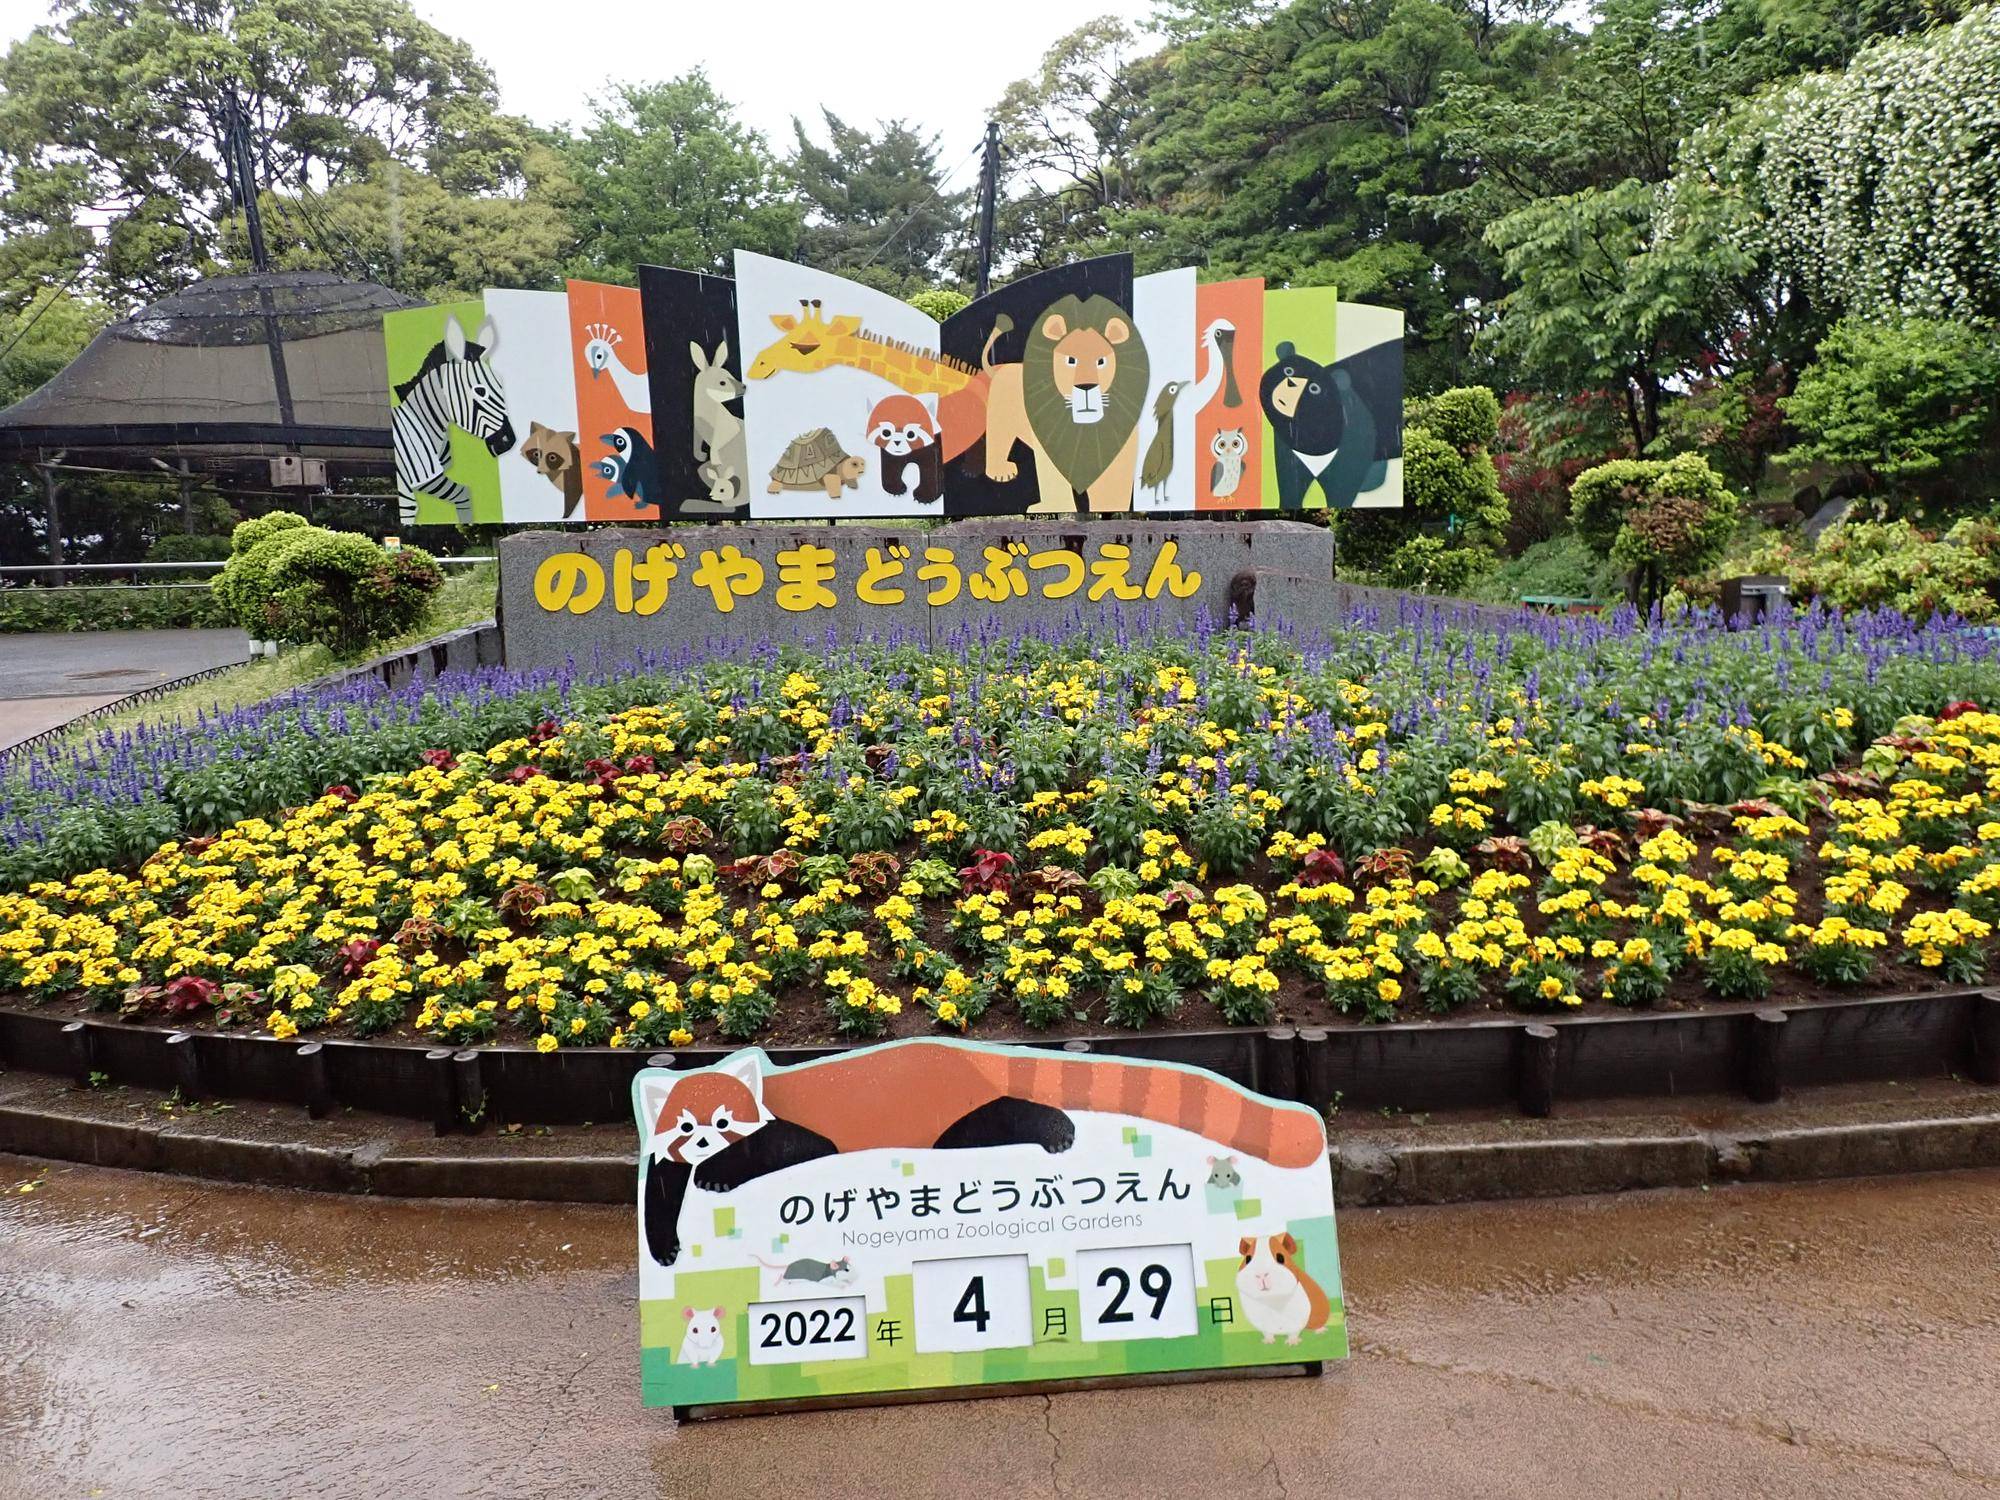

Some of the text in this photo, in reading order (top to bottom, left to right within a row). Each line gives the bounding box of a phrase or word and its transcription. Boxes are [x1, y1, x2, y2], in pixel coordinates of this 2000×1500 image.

[533, 541, 1202, 616] のげやまどうぶつえん
[779, 1168, 1191, 1226] のげやまどうぶつえん
[842, 1212, 1143, 1249] Nogeyama Zoological Gardens
[760, 1264, 1234, 1348] 2022 年 4 月 29 日
